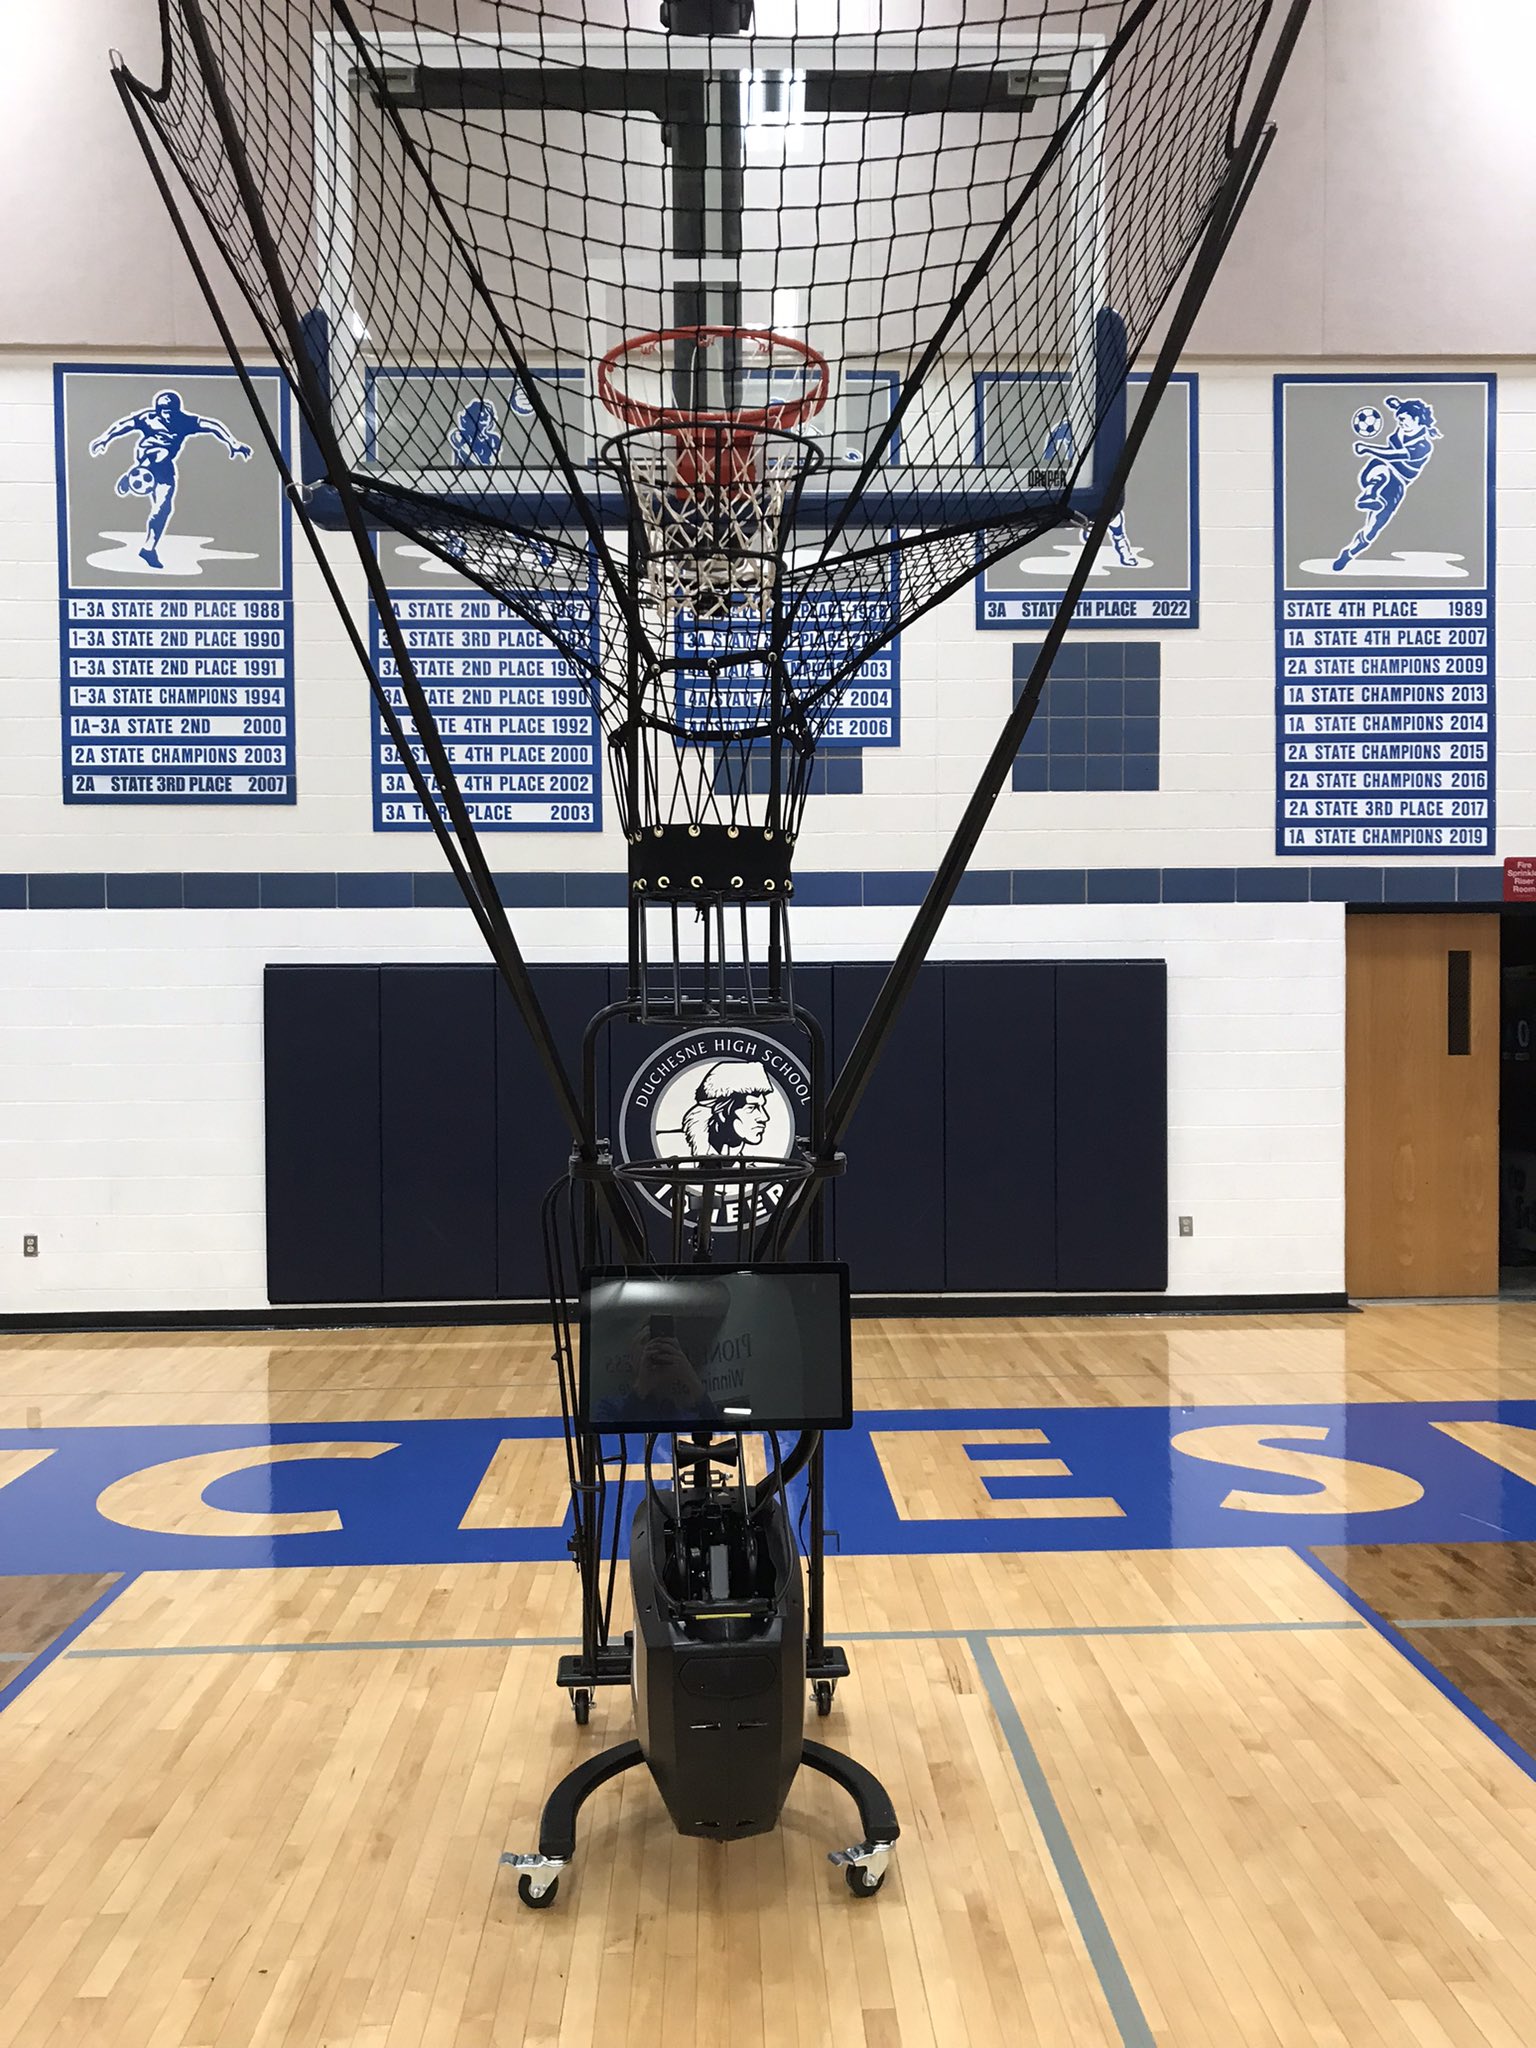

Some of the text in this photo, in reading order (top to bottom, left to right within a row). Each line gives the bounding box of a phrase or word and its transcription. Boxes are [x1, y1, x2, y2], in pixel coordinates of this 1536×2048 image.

[72, 602, 280, 618] 1-3A STATE 2ND PLACE 1988
[408, 603, 454, 618] STATE
[461, 603, 490, 618] 2ND
[988, 602, 1006, 617] 3A
[1096, 602, 1137, 617] PLACE
[1152, 602, 1188, 617] 2022
[1287, 602, 1483, 617] STATE 4TH PLACE 1989
[72, 631, 280, 646] 1-3A STATE 2ND PLACE 1990
[409, 632, 454, 647] STATE
[462, 632, 491, 647] 3RD
[498, 632, 544, 647] PLACE
[687, 632, 706, 648] 3A
[714, 632, 758, 648] STATE
[1288, 630, 1486, 646] 1A STATE 4TH PLACE 2007
[73, 660, 277, 676] 1-3A STATE 2ND PLACE 1991
[462, 660, 492, 676] 2ND
[499, 660, 544, 676] PLACE
[1288, 659, 1484, 674] 2A STATE CHAMPIONS 2009
[74, 689, 281, 704] 1-3A STATE CHAMPIONS 1994
[384, 689, 402, 704] 3A
[462, 689, 492, 704] 2ND
[500, 689, 545, 704] PLACE
[552, 689, 588, 704] 1990
[851, 691, 888, 706] 2004
[1289, 686, 1484, 702] 1A STATE CHAMPIONS 2013
[74, 718, 282, 734] 1A-3A STATE 2ND 2000
[464, 718, 492, 734] 4TH
[500, 718, 546, 734] PLACE
[552, 718, 588, 734] 1992
[850, 720, 888, 735] 2006
[1288, 716, 1484, 732] 1A STATE CHAMPIONS 2014
[75, 748, 282, 764] 2A STATE CHAMPIONS 2003
[465, 747, 493, 762] 4TH
[500, 747, 546, 762] PLACE
[551, 747, 588, 762] 2000
[1288, 744, 1484, 760] 2A STATE CHAMPIONS 2015
[76, 776, 284, 792] 2A STATE 3RD PLACE 2007
[386, 776, 406, 791] 3A
[464, 776, 492, 791] 4TH
[500, 776, 546, 791] PLACE
[550, 776, 589, 791] 2002
[1290, 773, 1486, 788] 2A STATE CHAMPIONS 2016
[386, 805, 406, 820] 3A
[550, 805, 590, 820] 2003
[1289, 801, 1484, 816] 2A STATE 3RD PLACE 2017
[1289, 829, 1482, 844] 1A STATE CHAMPIONS 2019
[1517, 861, 1532, 869] Fire
[635, 1039, 812, 1108] DUCHESNE HIGH SCHOOL
